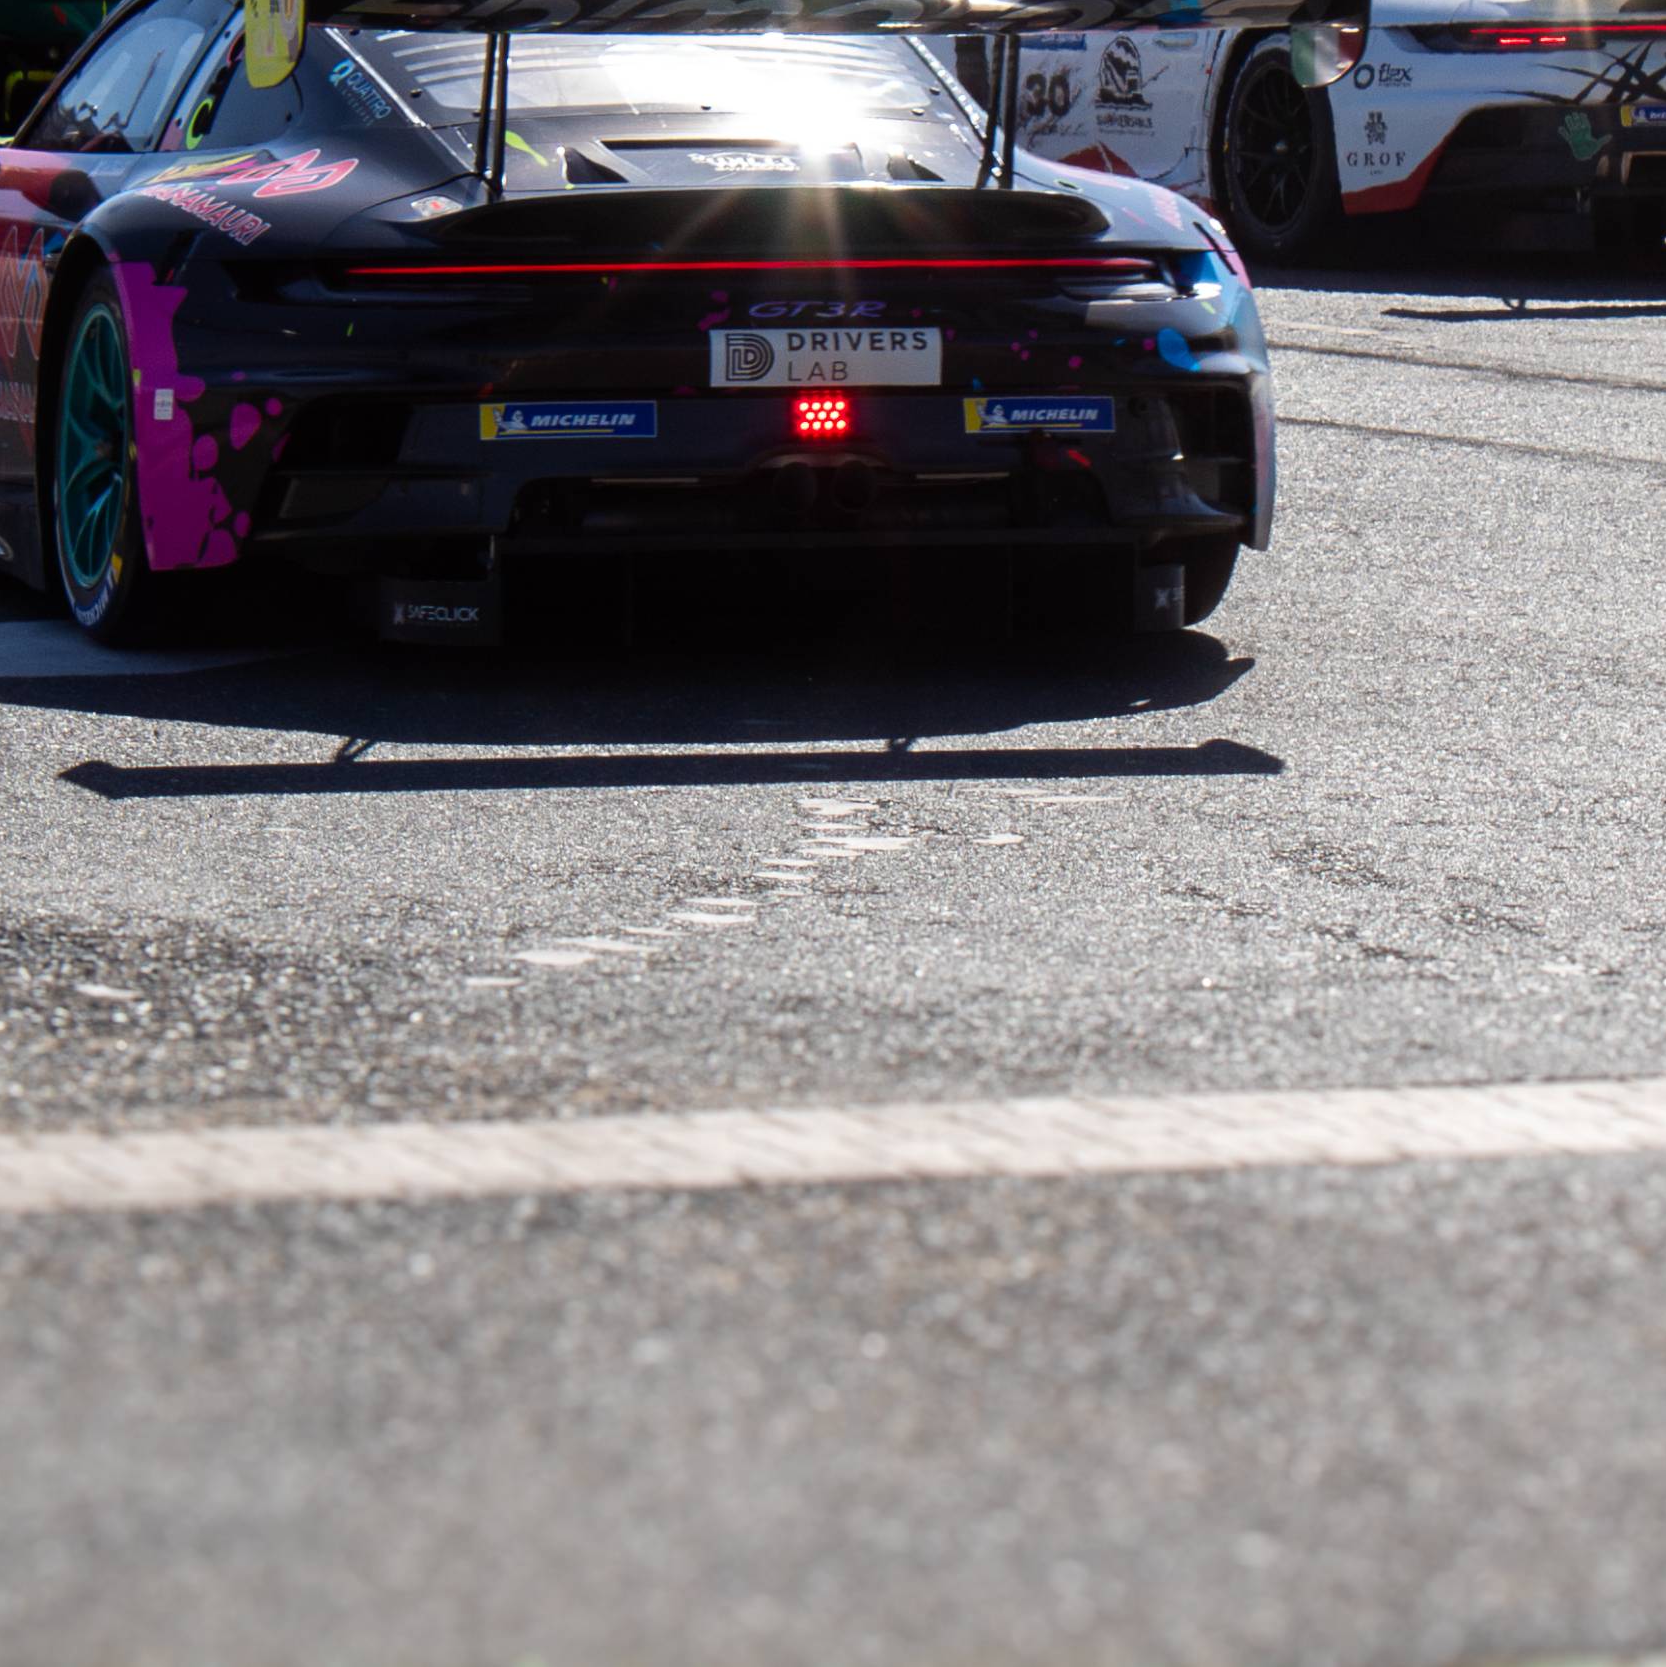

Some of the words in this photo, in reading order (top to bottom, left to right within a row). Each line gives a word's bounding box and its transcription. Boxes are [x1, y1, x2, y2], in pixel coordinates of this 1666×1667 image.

[1025, 73, 1070, 117] 30
[1346, 151, 1407, 167] GROF
[787, 332, 928, 351] DRIVERS
[787, 361, 849, 382] LAB
[531, 414, 636, 427] MICHELIN
[1010, 409, 1099, 421] MICHELIN
[407, 604, 480, 622] SAFECLICK
